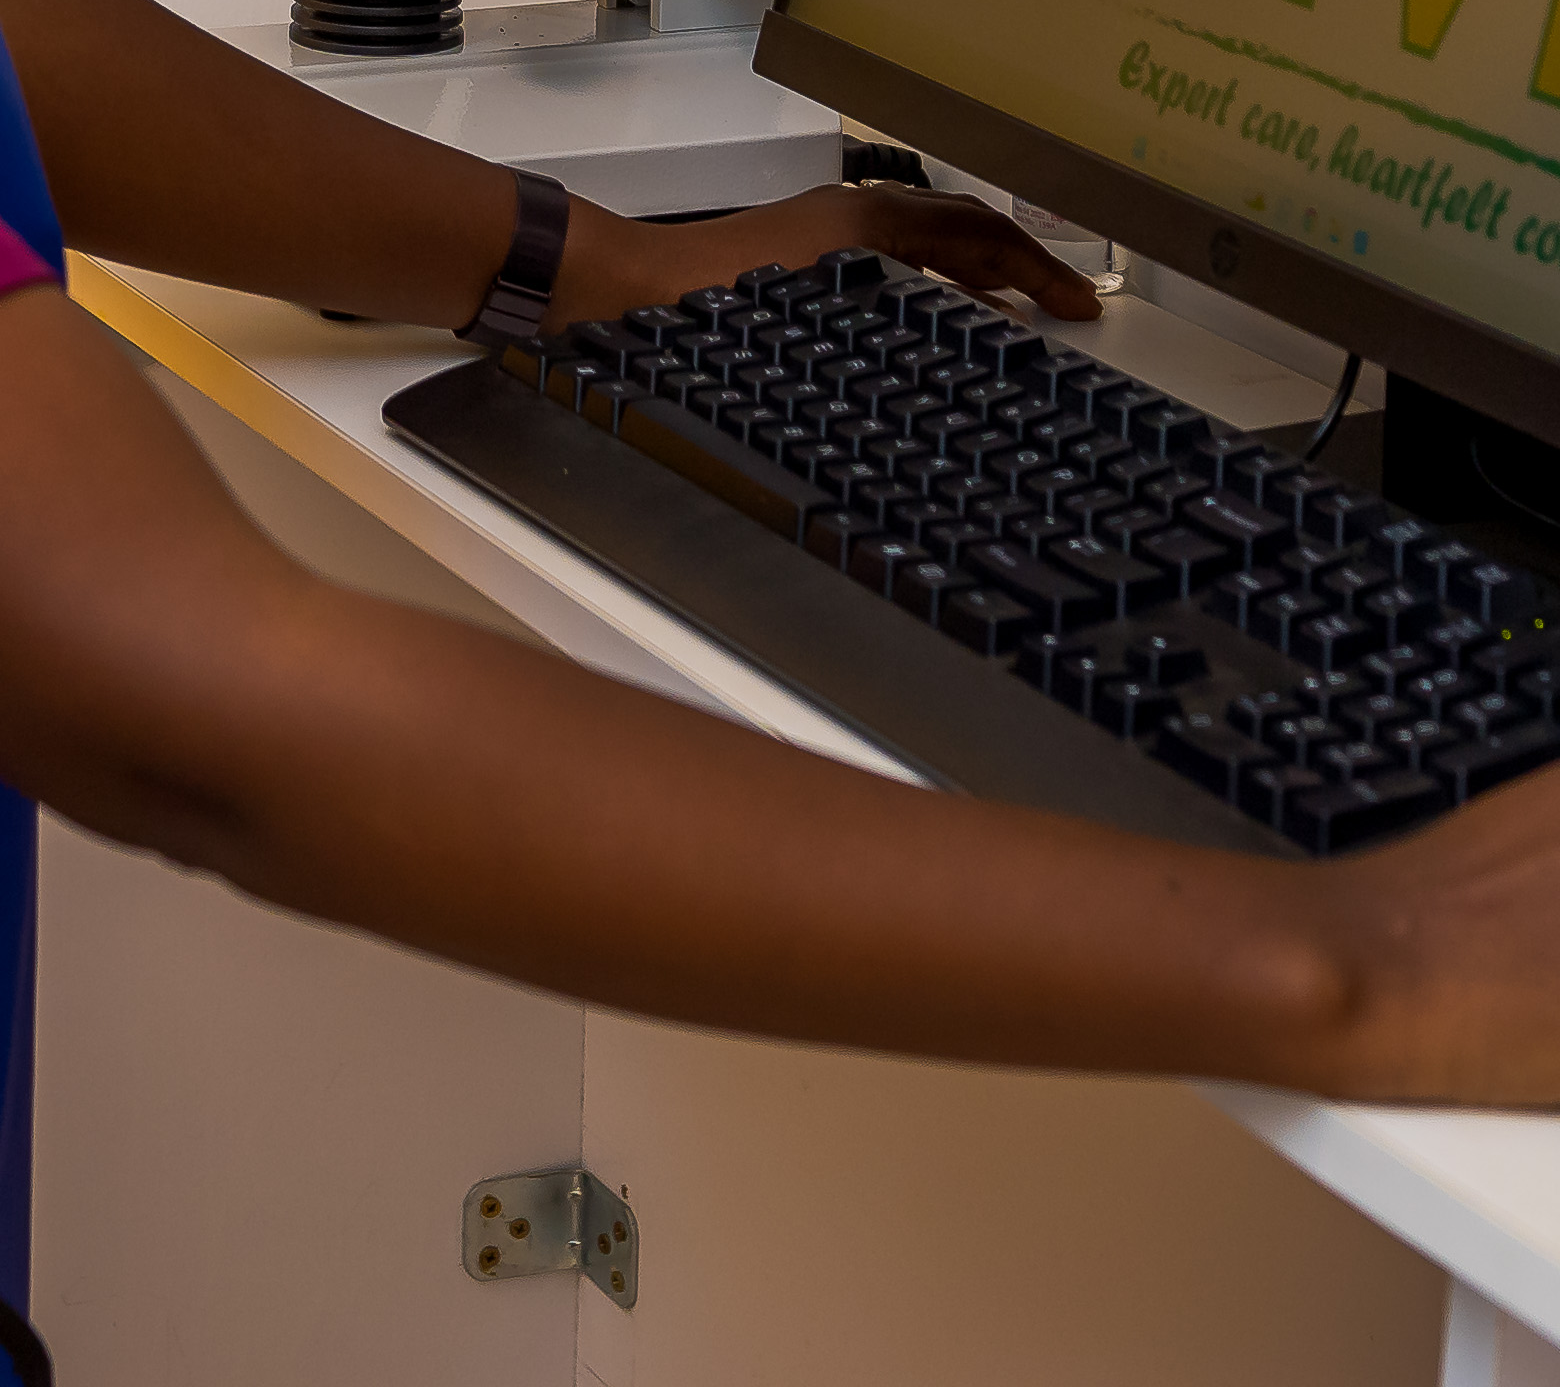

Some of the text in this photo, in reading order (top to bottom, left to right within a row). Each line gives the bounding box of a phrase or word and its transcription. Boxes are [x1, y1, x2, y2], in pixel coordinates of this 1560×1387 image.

[1117, 40, 1240, 128] Expert
[1240, 102, 1321, 173] care,
[1327, 128, 1512, 241] heartfelt
